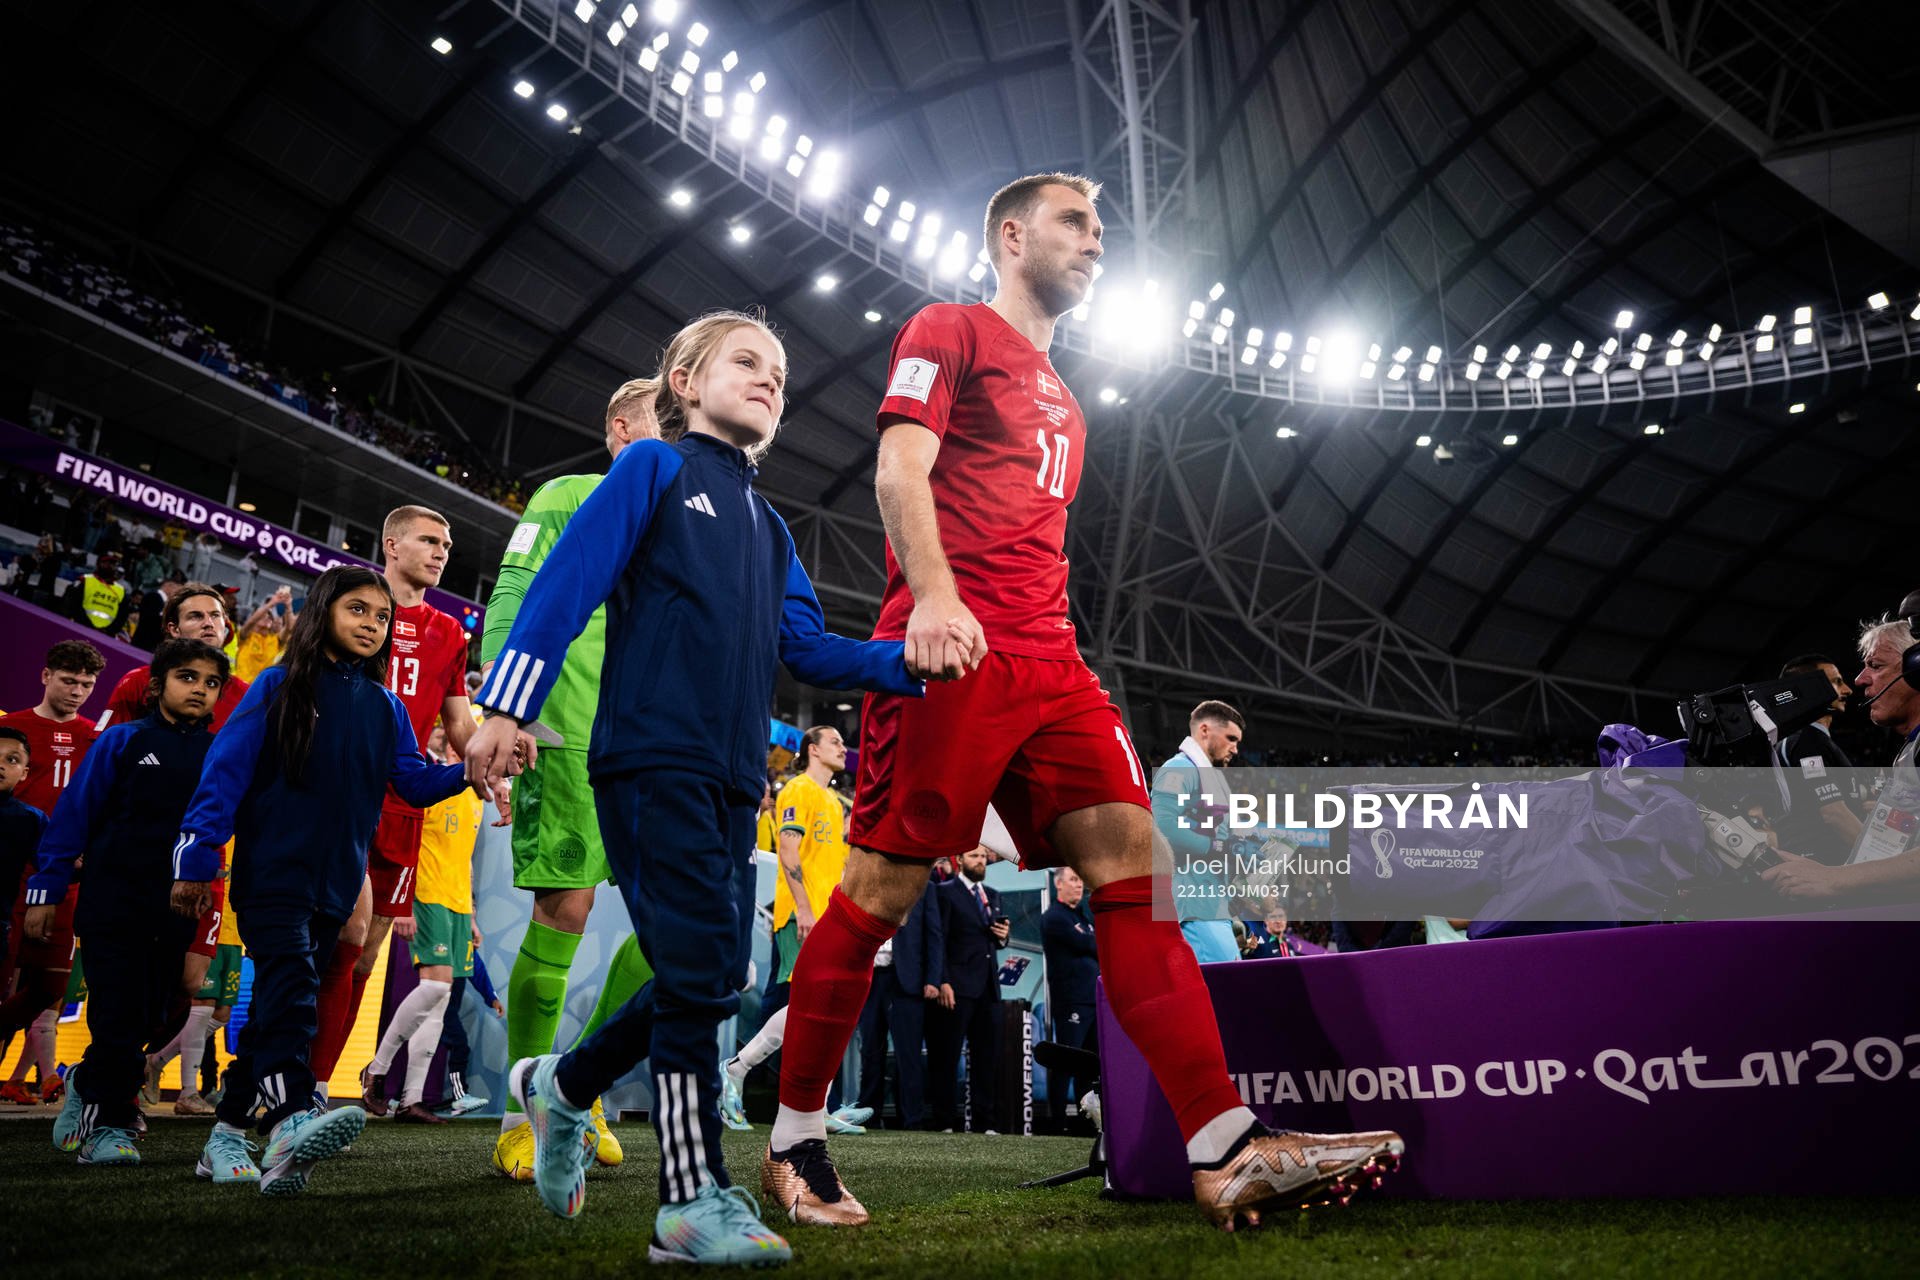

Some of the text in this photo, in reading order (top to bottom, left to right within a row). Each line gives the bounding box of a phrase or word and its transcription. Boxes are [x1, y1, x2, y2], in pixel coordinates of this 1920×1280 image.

[1036, 428, 1069, 499] 10
[56, 452, 115, 493] FIFA
[117, 475, 208, 525] WORLD
[209, 511, 256, 543] CUP
[391, 656, 420, 696] 13
[53, 759, 71, 788] 11
[1814, 783, 1839, 796] FIFA
[445, 813, 458, 834] 19
[813, 820, 832, 843] 22
[1399, 847, 1484, 859] FIFA WORLD CUP
[1403, 856, 1479, 869] Qatar2022
[205, 911, 221, 945] 2
[1023, 1009, 1033, 1137] POWERADE
[1228, 1071, 1304, 1105] IFA
[1304, 1064, 1466, 1103] WORLD
[1475, 1059, 1567, 1097] CUP
